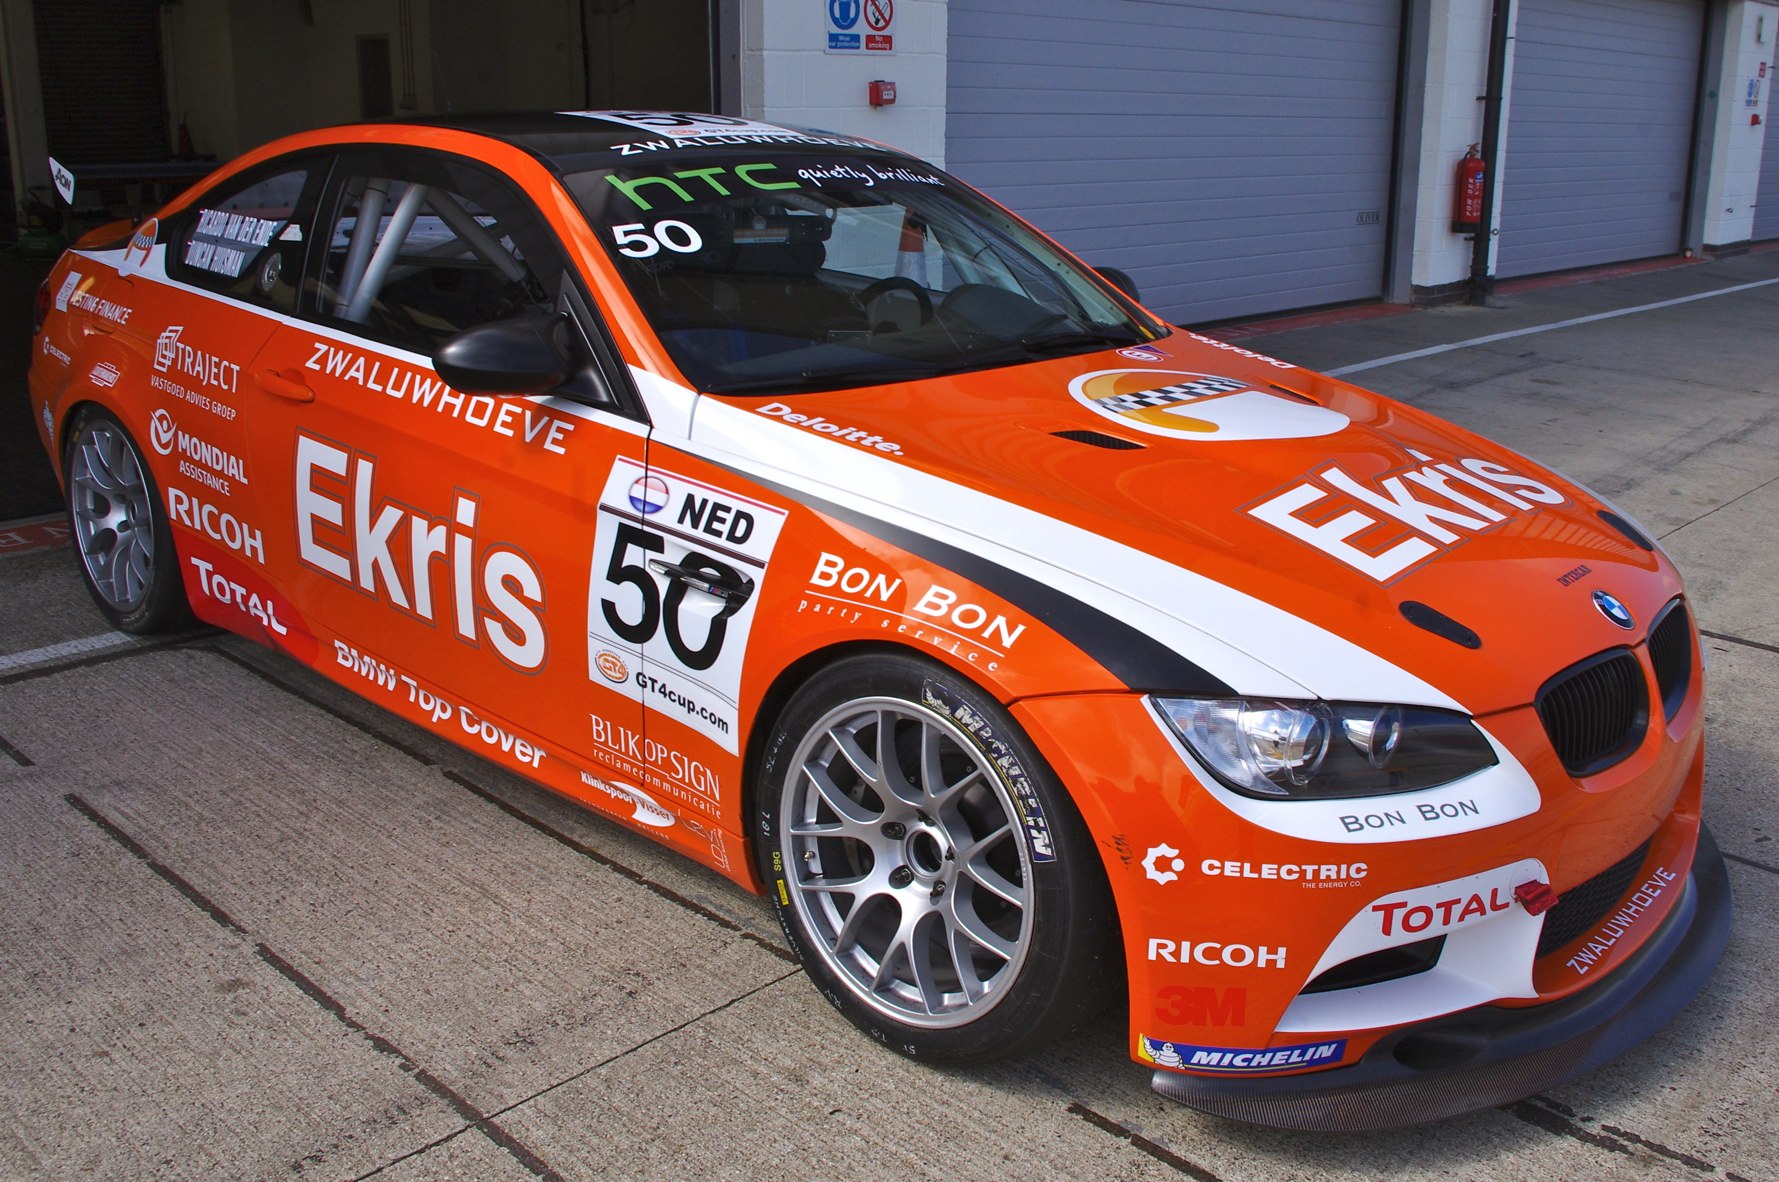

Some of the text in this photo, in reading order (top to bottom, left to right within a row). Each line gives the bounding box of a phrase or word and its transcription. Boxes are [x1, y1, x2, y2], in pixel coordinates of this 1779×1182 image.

[798, 164, 875, 188] quietly
[866, 165, 945, 187] brilliant
[611, 219, 702, 259] 50
[97, 299, 133, 324] FINANCE
[176, 341, 241, 394] TRAJECT
[151, 374, 236, 422] VASTGOED ADVIES GROEP
[304, 341, 575, 456] ZWALUWHOEVE
[178, 430, 248, 485] MONDIAL
[179, 459, 231, 497] ASSISTANCE
[167, 486, 265, 565] RICOH
[677, 492, 755, 545] NED
[1246, 448, 1566, 583] Ekris
[296, 433, 546, 669] Ekris
[190, 556, 288, 636] TOTAL
[600, 521, 748, 671] 50
[808, 551, 1027, 649] BON BON
[797, 600, 999, 672] party service
[334, 639, 547, 769] BMW Top Cover
[635, 670, 729, 735] GT4cup.com
[580, 770, 634, 804] Klinkspoor
[593, 748, 721, 820] reclamecommunicatie
[1338, 799, 1480, 833] BON BON
[772, 851, 782, 872] S9G
[1200, 858, 1368, 880] CELECTRIC
[1318, 881, 1347, 889] ENERGY
[1371, 887, 1512, 937] TOTAL
[1566, 866, 1676, 975] ZWALUWHOEVE
[1147, 938, 1287, 969] RICOH
[1154, 985, 1247, 1027] 3M
[1188, 1042, 1338, 1069] MICHELIN
